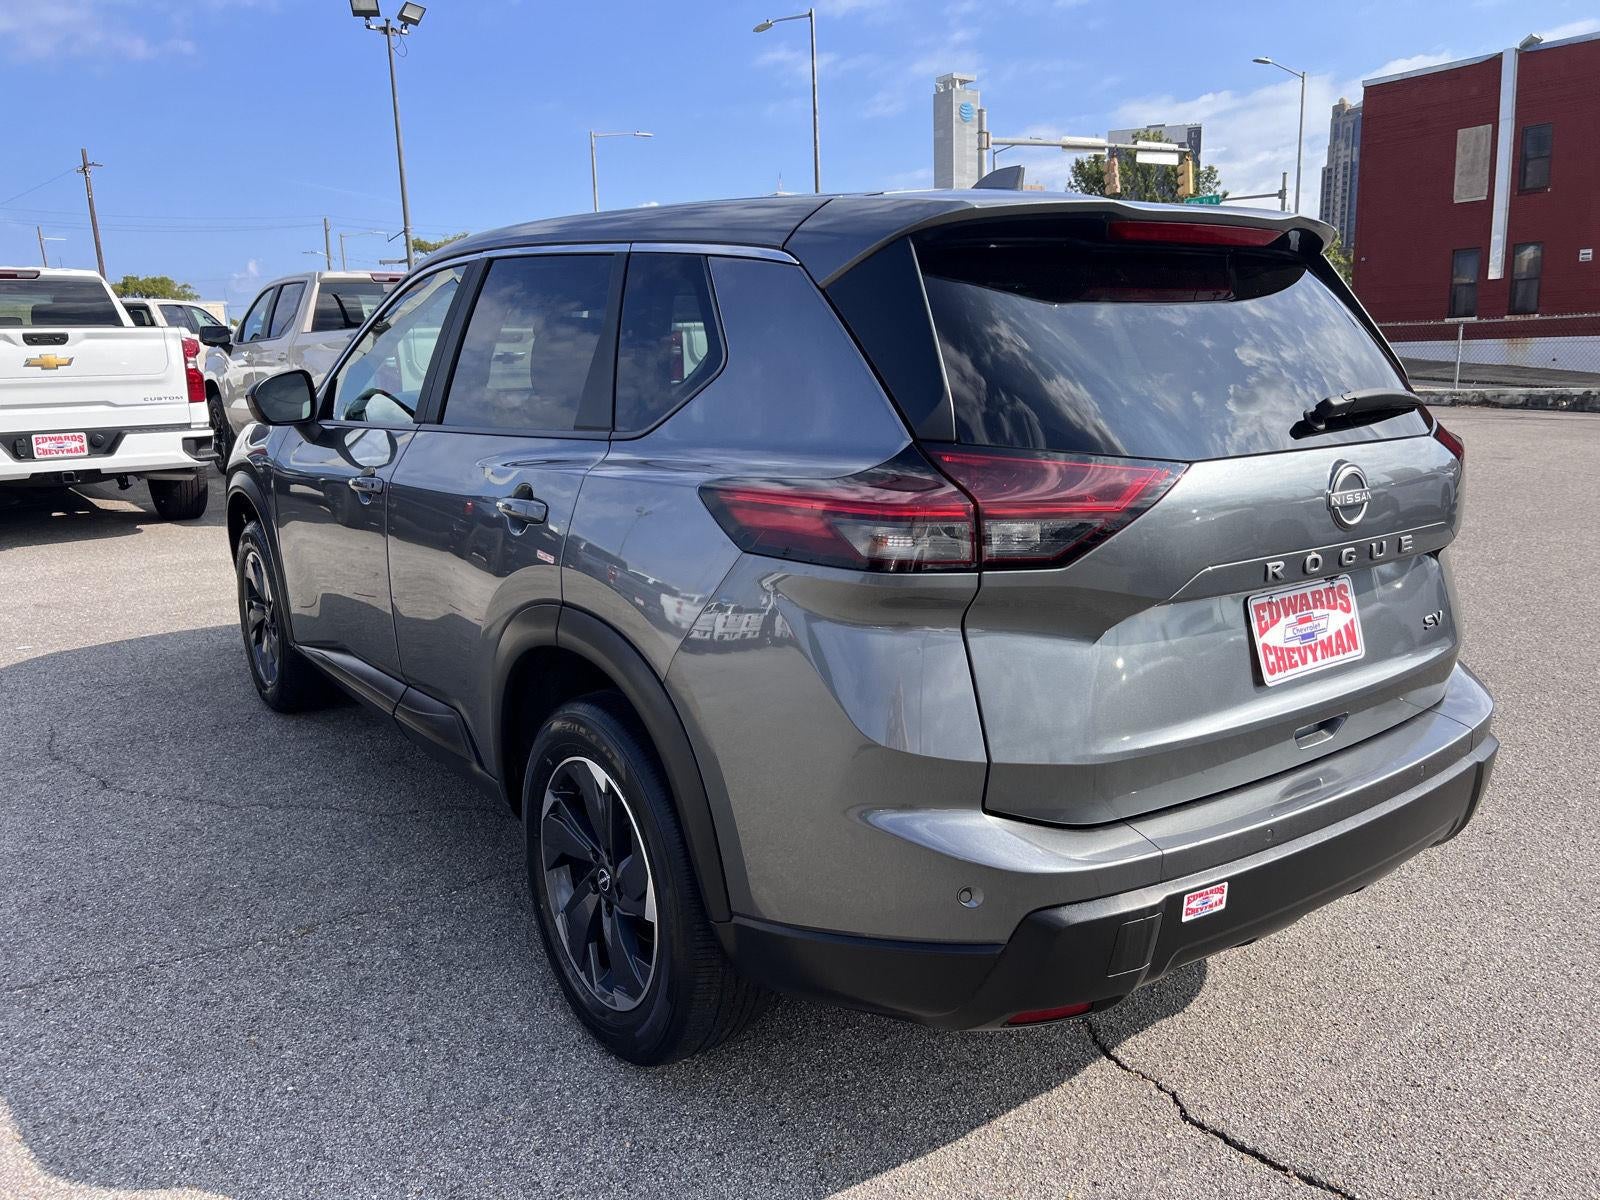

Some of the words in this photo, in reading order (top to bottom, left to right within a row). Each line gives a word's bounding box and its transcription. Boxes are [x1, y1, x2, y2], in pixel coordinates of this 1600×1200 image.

[34, 434, 84, 446] EDWARDS
[36, 445, 86, 456] CHEVYMAN
[1331, 491, 1371, 505] NISSAN
[1265, 535, 1414, 582] ROGUE
[1253, 583, 1352, 638] EDWARDS
[1423, 610, 1443, 629] SV
[1292, 622, 1321, 636] Chevrolet
[1261, 617, 1360, 676] CHEVYMAN
[1187, 885, 1225, 906] EDWARDS
[1185, 897, 1224, 916] CHEVYMAN
